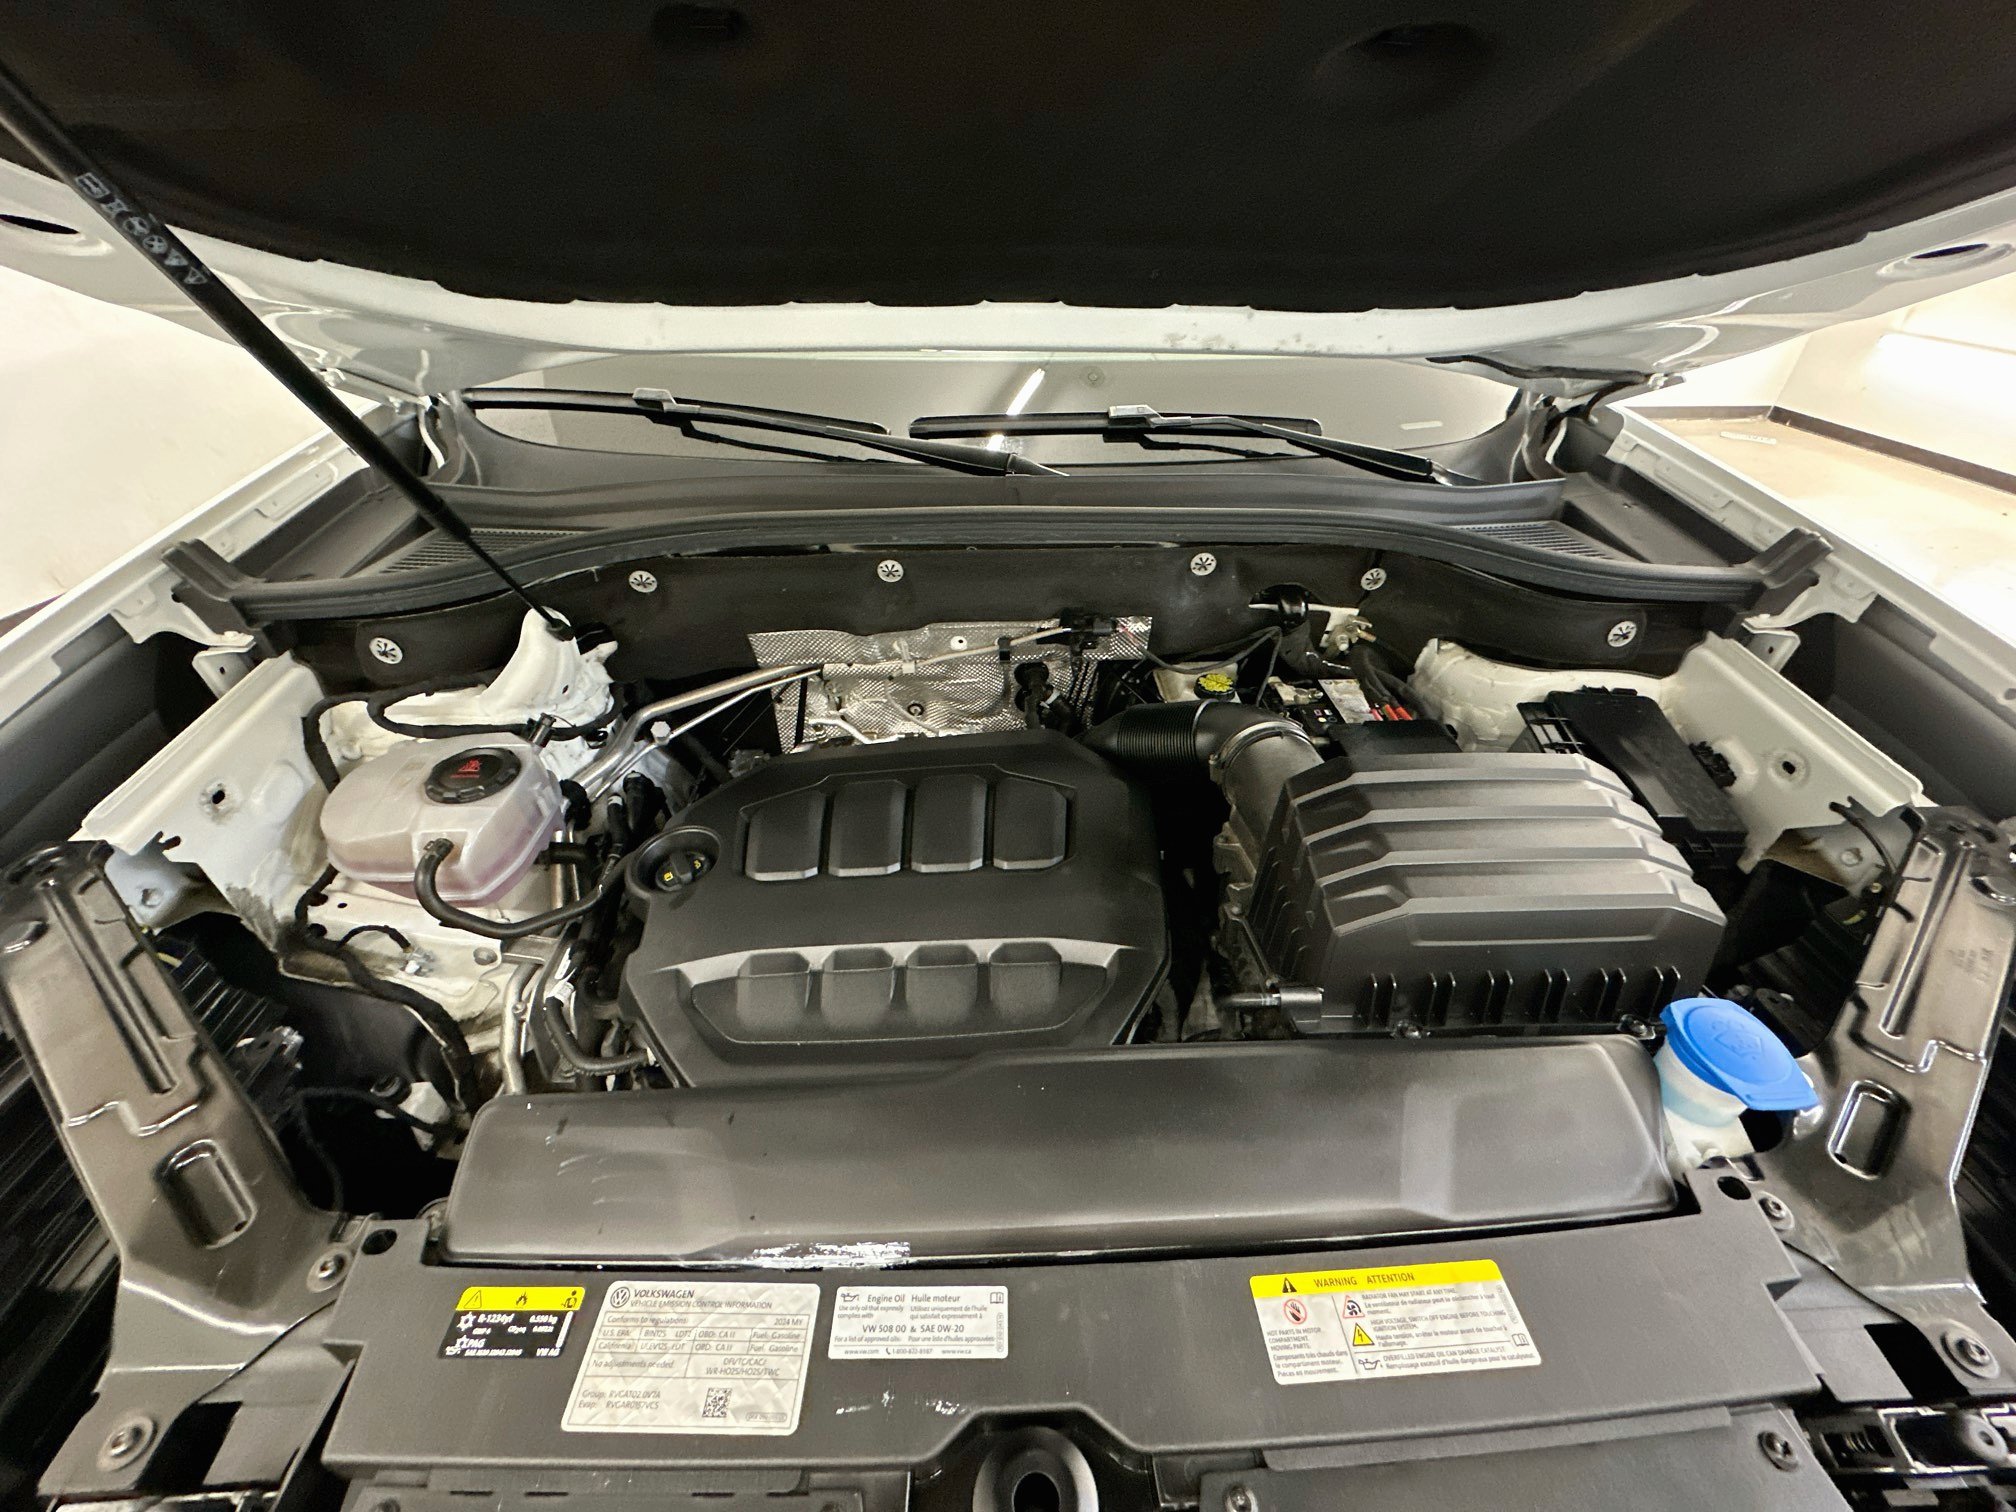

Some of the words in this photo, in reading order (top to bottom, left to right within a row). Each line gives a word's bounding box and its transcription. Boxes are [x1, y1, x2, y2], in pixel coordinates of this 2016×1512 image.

[1314, 1277, 1358, 1288] WARNING
[1367, 1272, 1415, 1284] ATTENTION
[634, 1289, 695, 1298] VOLKSWAGEN
[867, 1294, 892, 1304] Engine
[894, 1294, 906, 1302] Oil
[911, 1294, 931, 1303] Huile
[932, 1294, 961, 1303] moteur
[658, 1300, 691, 1308] EMISSION
[725, 1301, 773, 1309] INFORMATION
[774, 1318, 790, 1326] 2024
[791, 1318, 803, 1326] MY
[862, 1325, 877, 1333] VW
[879, 1325, 893, 1333] 508
[895, 1325, 907, 1333] 00
[920, 1325, 935, 1333] SAE
[937, 1325, 965, 1333] 0W-20
[1267, 1328, 1278, 1336] HOT
[1273, 1353, 1305, 1361] Composants
[603, 1360, 646, 1369] adjustments
[1282, 1360, 1320, 1370] compartiment
[1386, 1361, 1419, 1370] Remplissage
[582, 1390, 606, 1400] Group:
